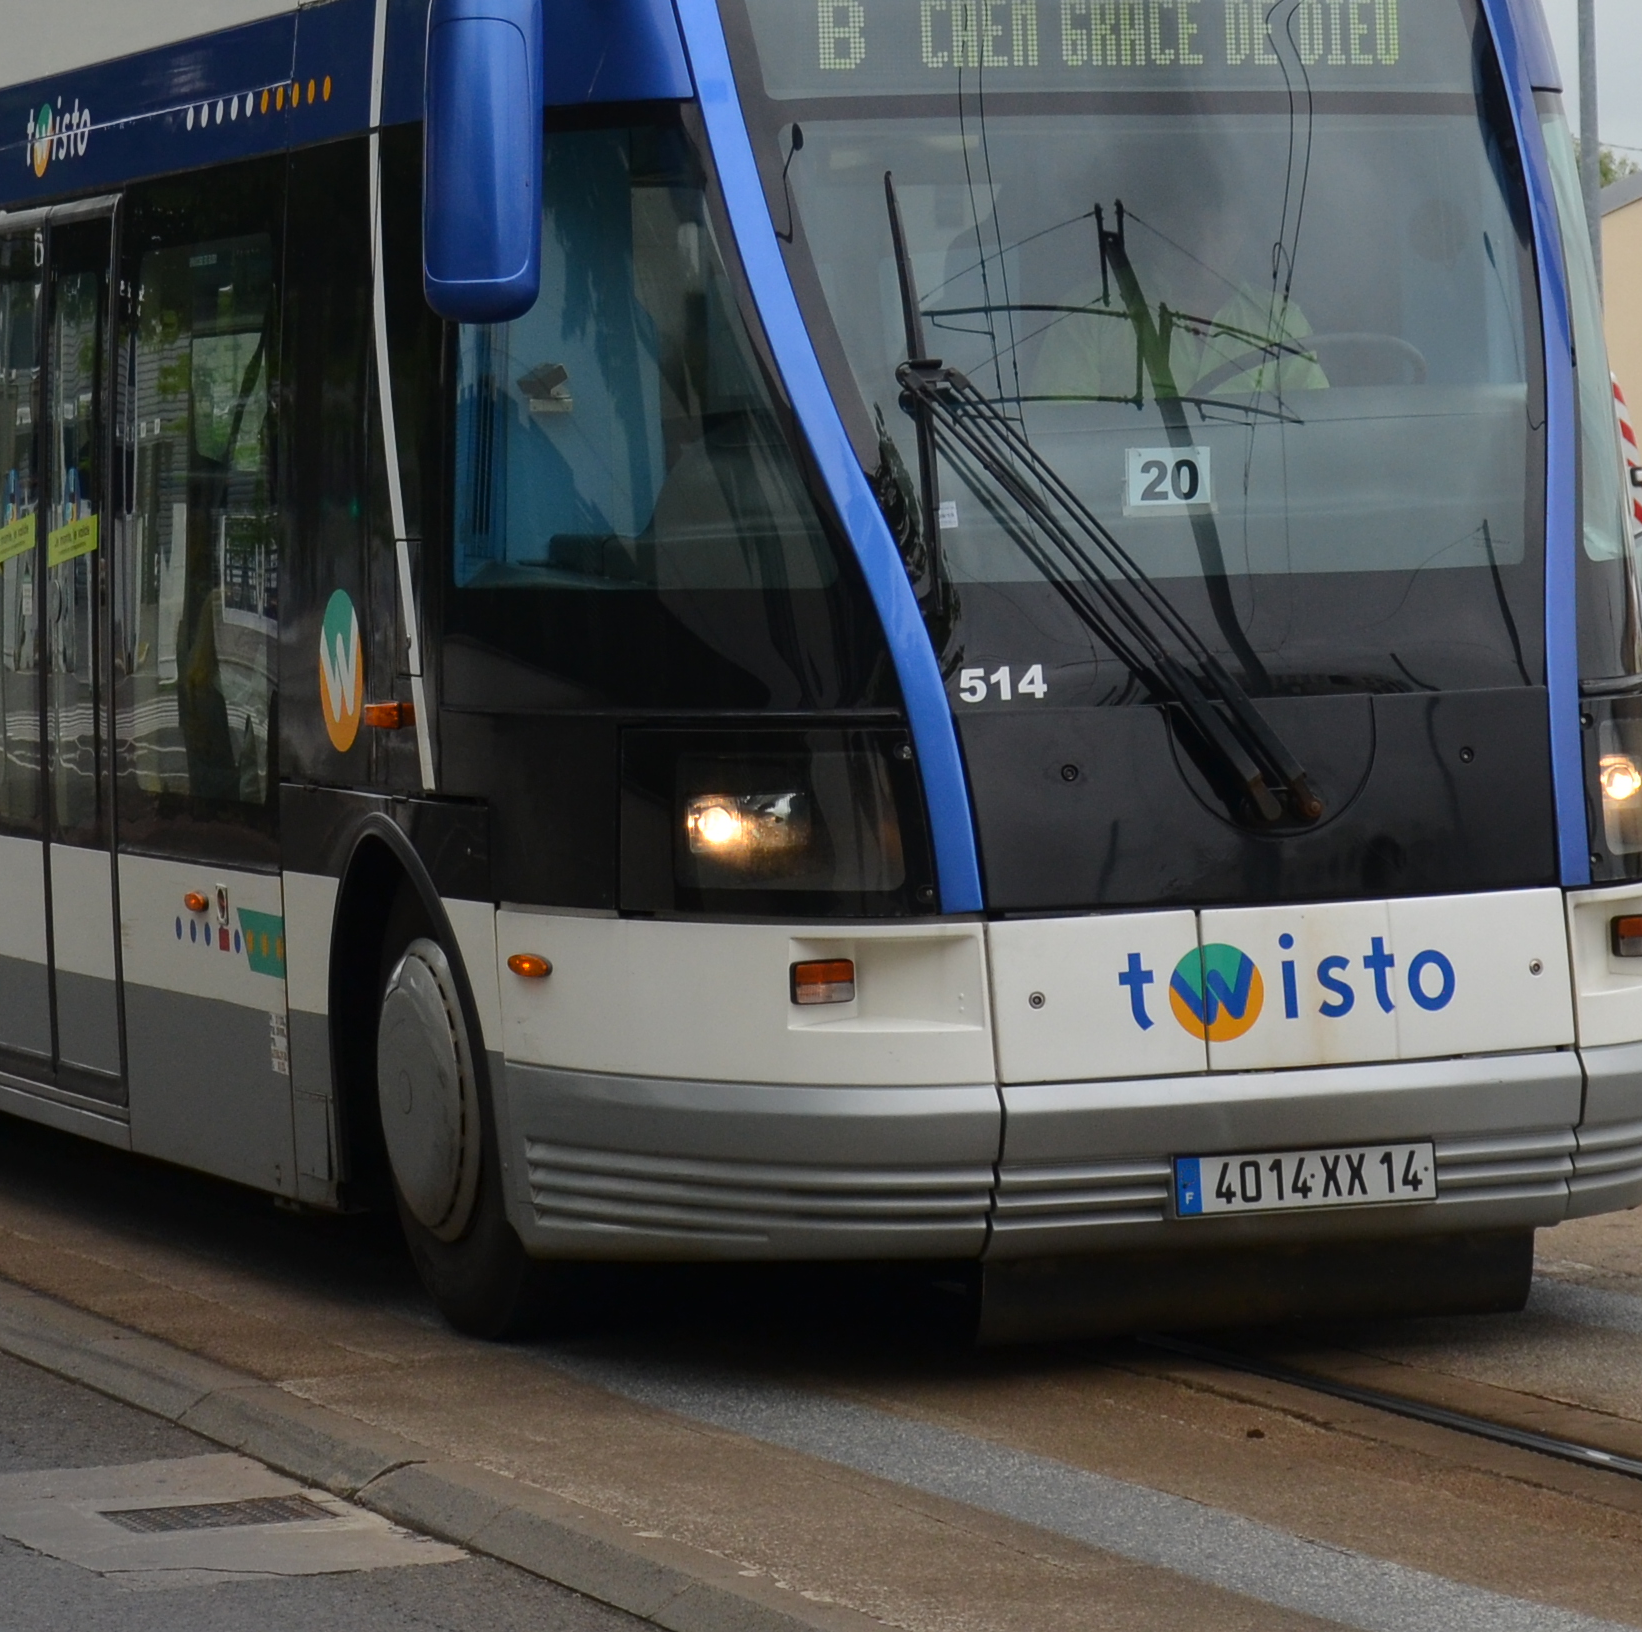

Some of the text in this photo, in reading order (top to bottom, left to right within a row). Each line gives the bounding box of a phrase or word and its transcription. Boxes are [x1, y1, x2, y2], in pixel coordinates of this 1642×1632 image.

[26, 96, 91, 172] twisto
[1140, 459, 1199, 501] 20
[959, 664, 1048, 703] 514
[1118, 933, 1456, 1036] twisto
[1185, 1150, 1424, 1205] F 4014 XX 14
